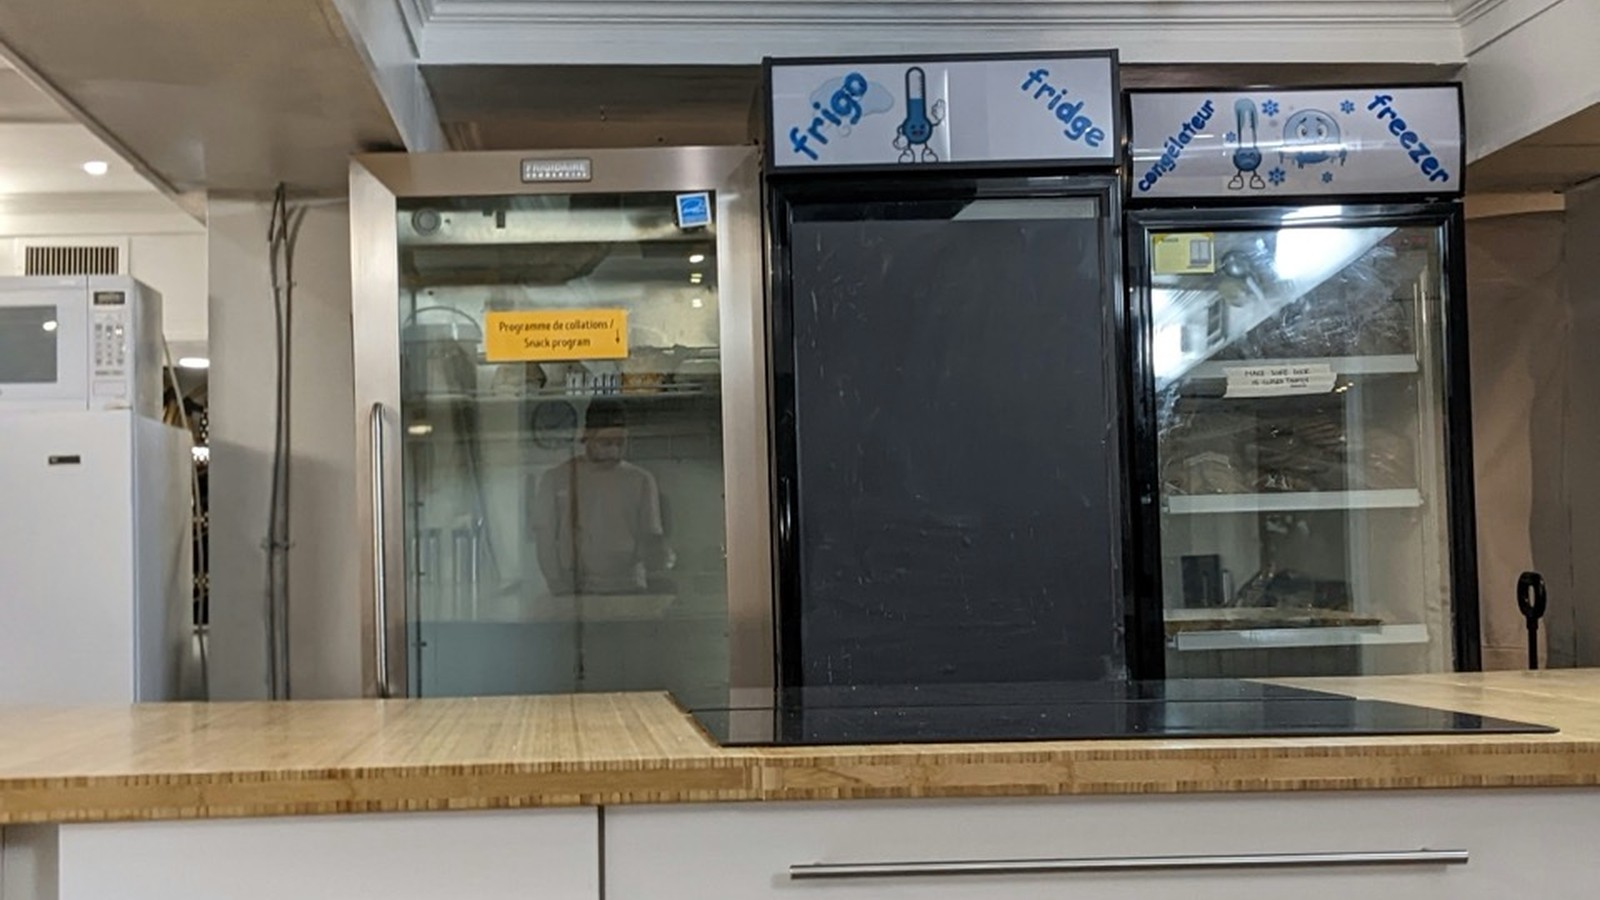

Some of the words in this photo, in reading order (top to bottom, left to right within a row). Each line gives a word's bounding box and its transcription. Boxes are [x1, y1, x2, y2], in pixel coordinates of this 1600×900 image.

[789, 72, 867, 160] frigo
[1021, 68, 1105, 147] fridge
[1138, 99, 1214, 191] congélateur
[1367, 94, 1449, 182] freezer
[499, 321, 551, 335] Programme
[553, 320, 564, 331] de
[565, 319, 608, 330] collations
[524, 338, 550, 348] Snack
[552, 338, 591, 350] program
